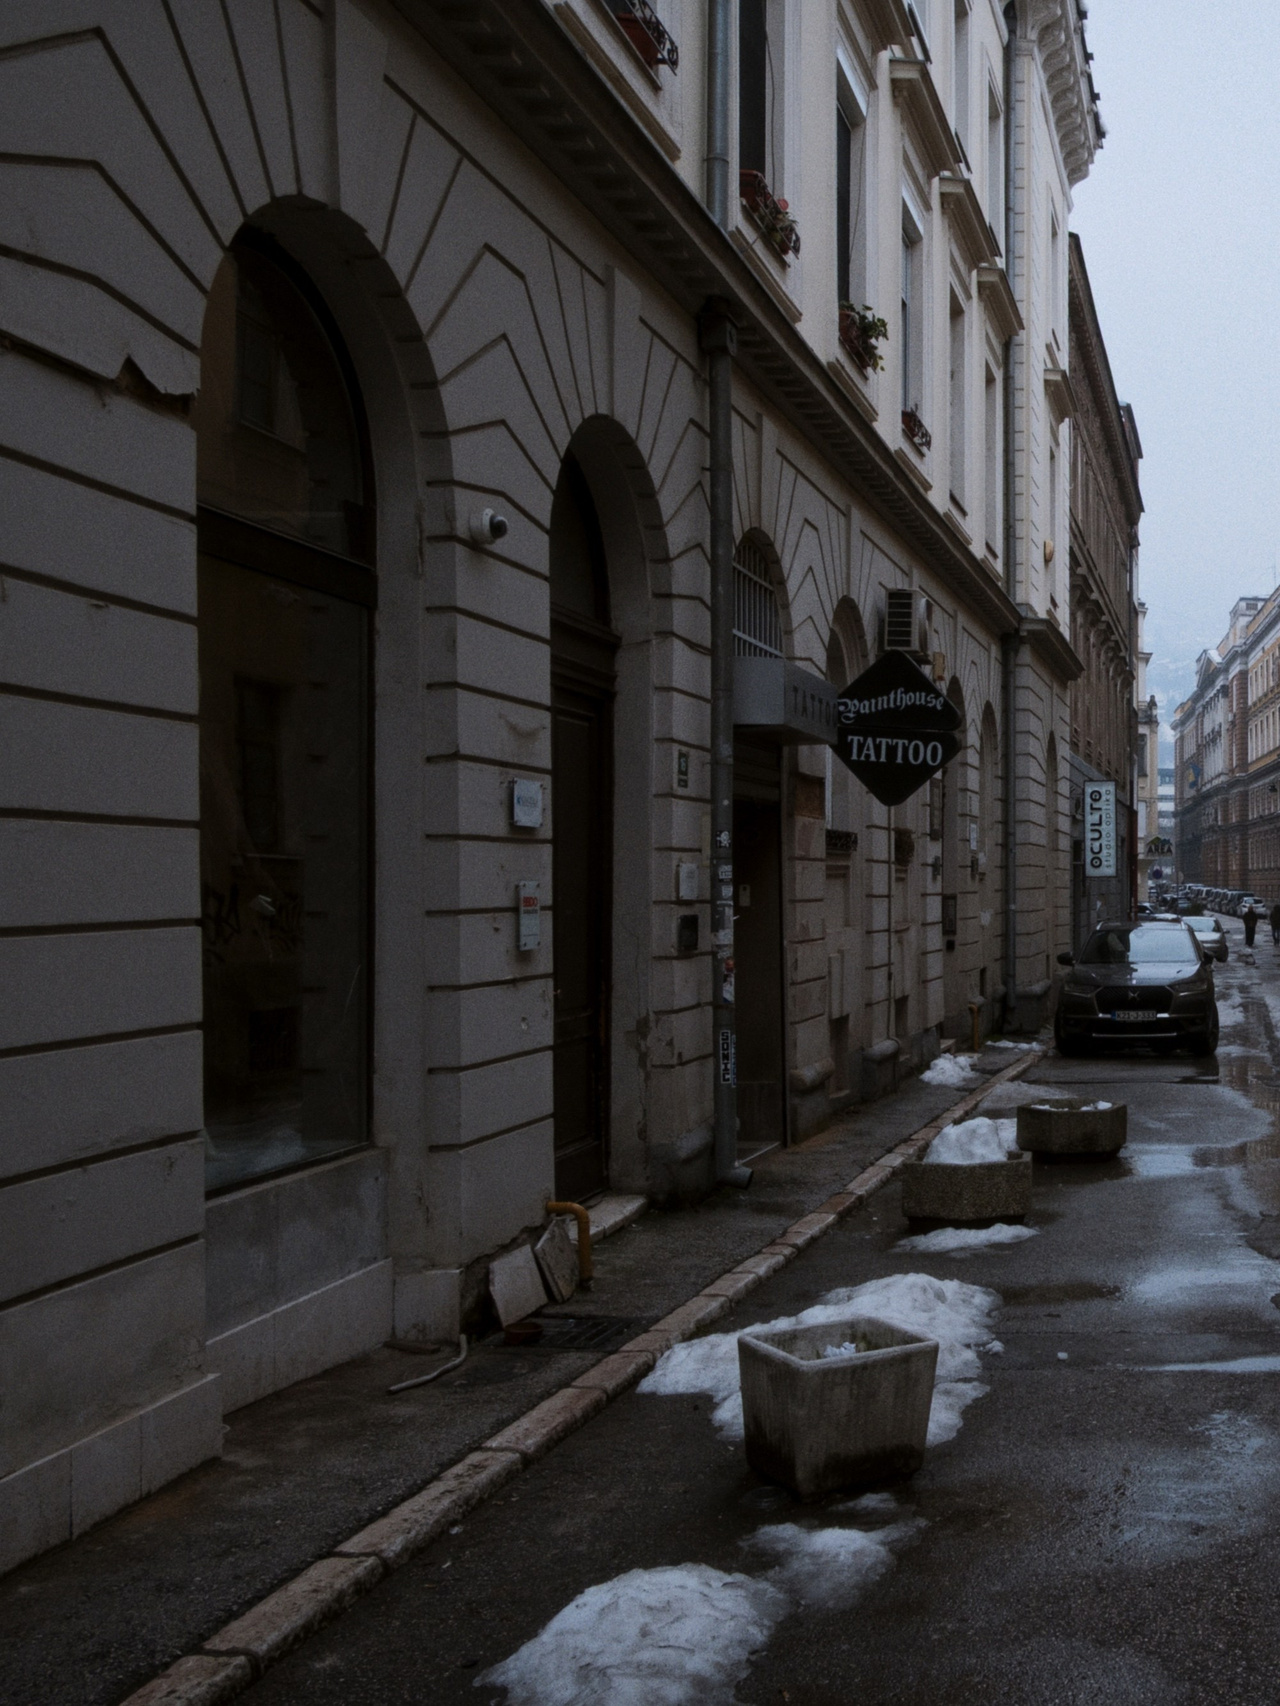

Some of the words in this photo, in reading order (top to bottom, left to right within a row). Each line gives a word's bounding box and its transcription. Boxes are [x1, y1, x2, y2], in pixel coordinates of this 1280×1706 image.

[837, 686, 944, 724] Painthouse
[847, 735, 943, 766] TATTOO
[1104, 789, 1112, 826] optika
[1090, 790, 1102, 868] OCULTO
[1104, 832, 1112, 868] studio
[1147, 845, 1173, 856] AREA
[721, 1031, 730, 1082] SONIC
